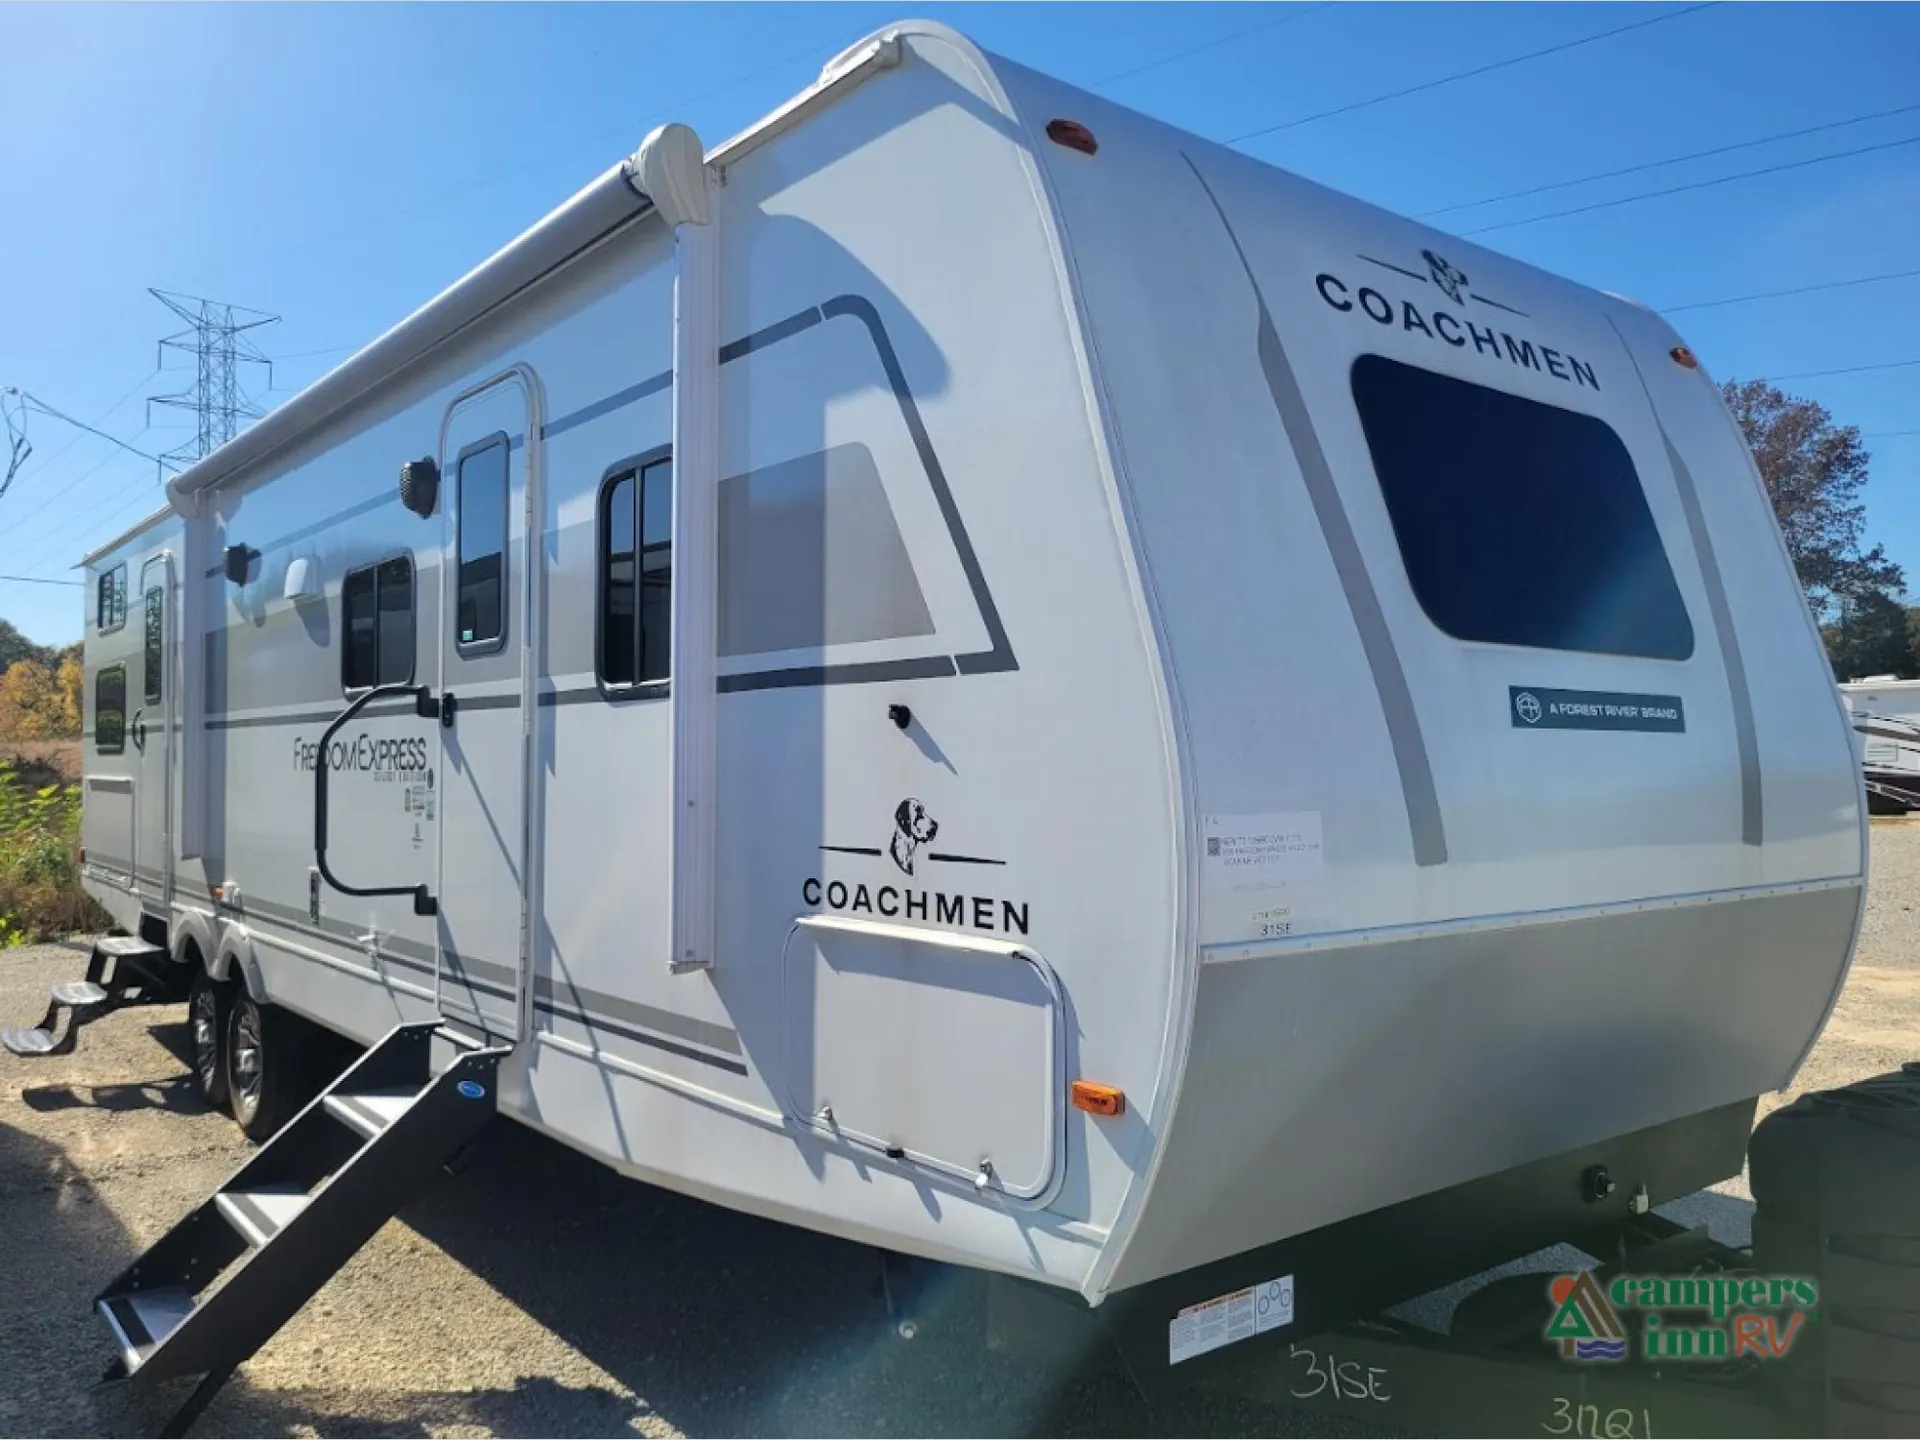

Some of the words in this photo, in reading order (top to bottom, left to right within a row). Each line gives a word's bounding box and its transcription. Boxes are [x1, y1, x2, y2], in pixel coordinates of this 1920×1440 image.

[1315, 272, 1600, 392] COACHMEN
[1560, 703, 1604, 716] FOREST
[1606, 705, 1637, 718] RIVER
[802, 877, 1029, 936] COACHMEN
